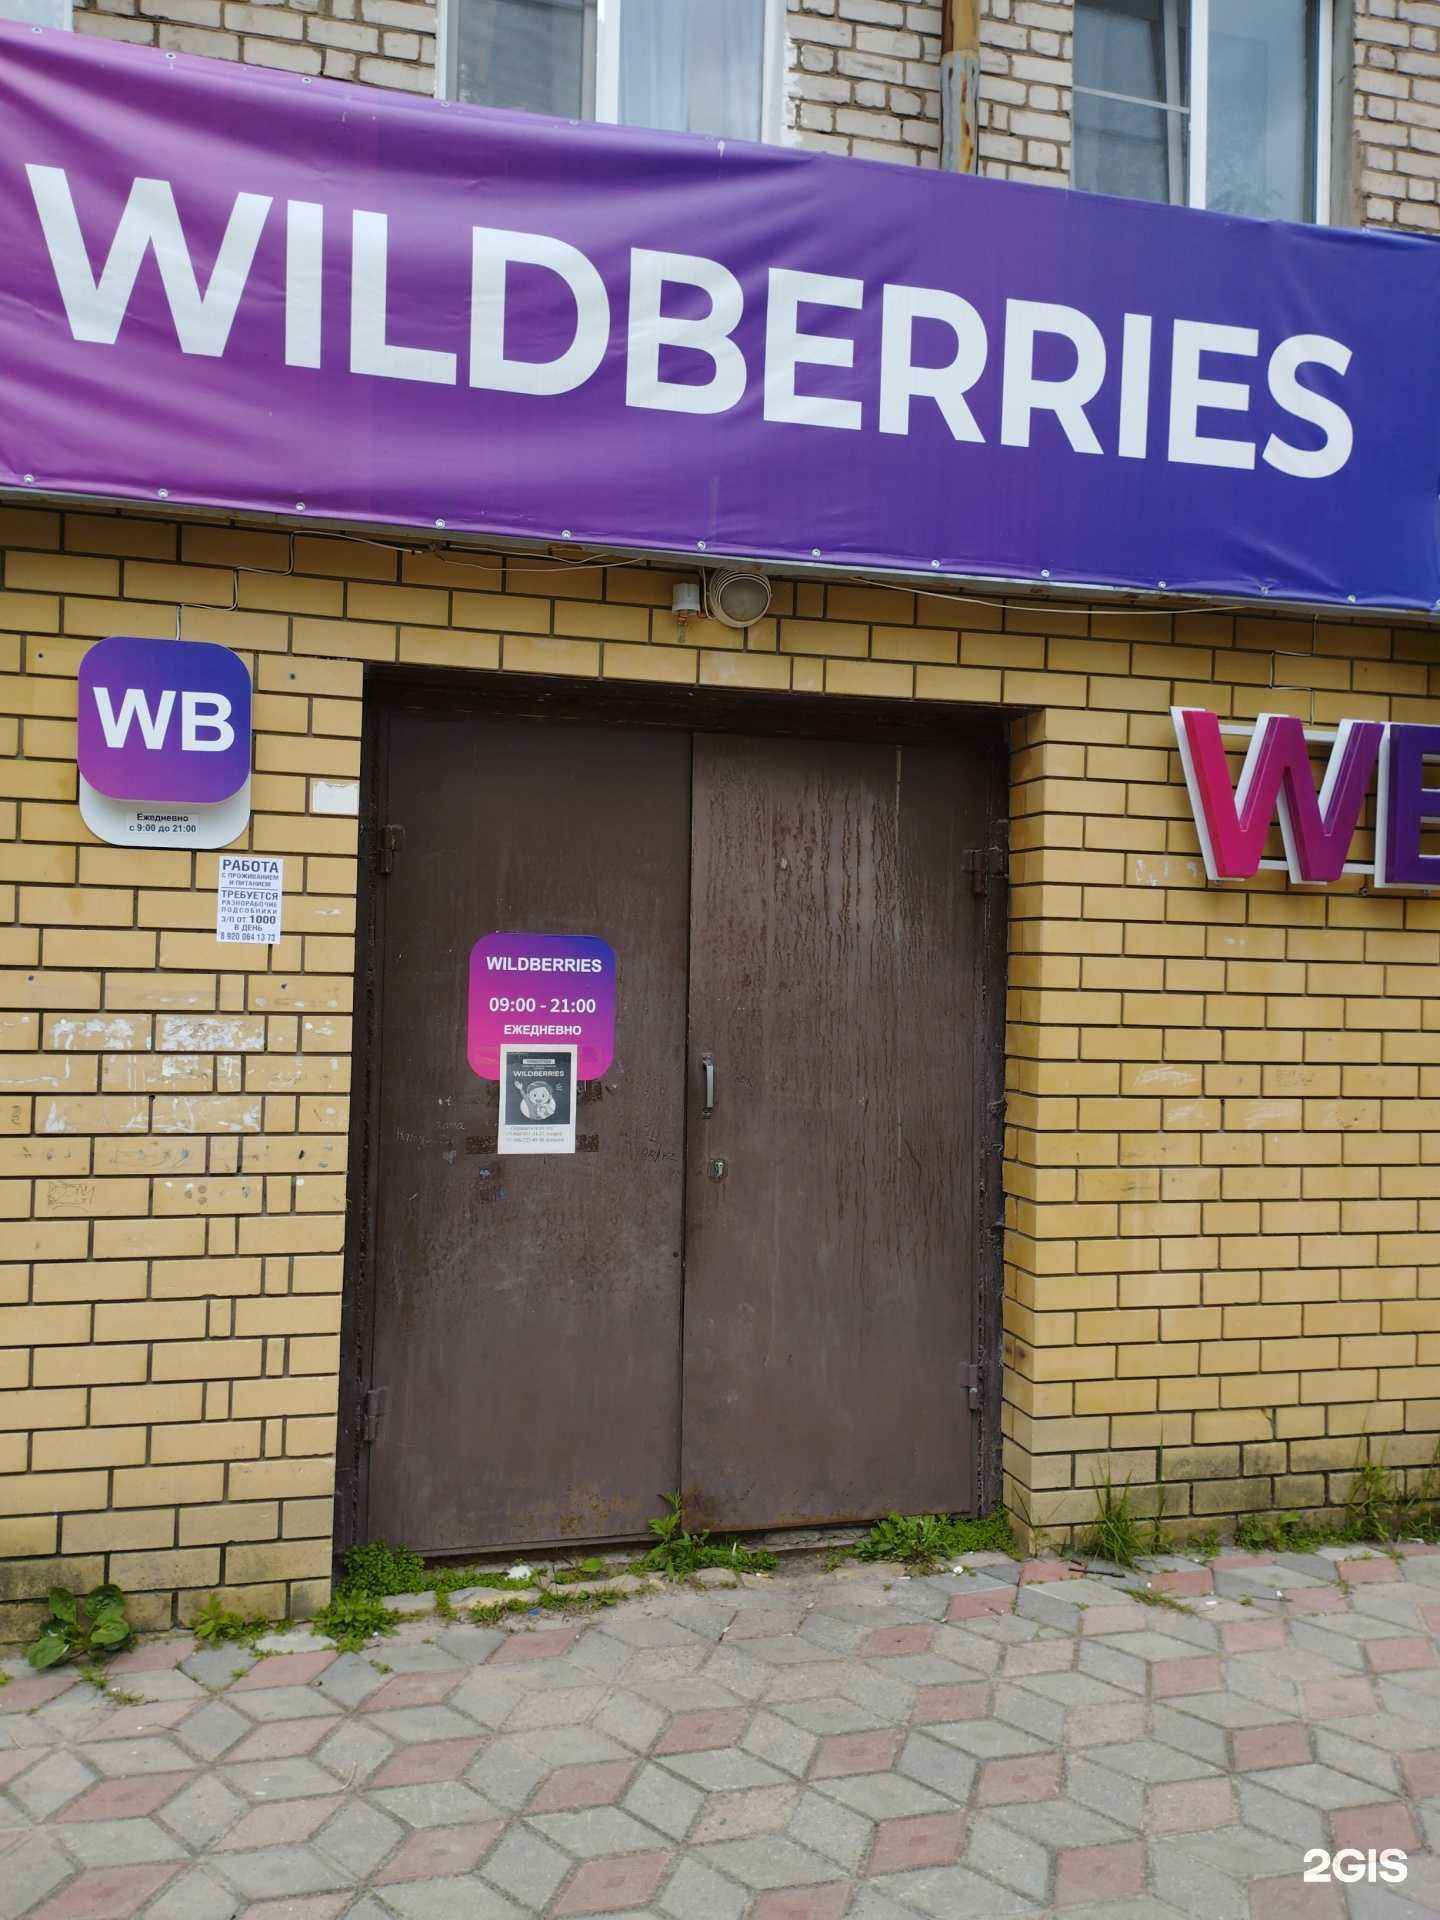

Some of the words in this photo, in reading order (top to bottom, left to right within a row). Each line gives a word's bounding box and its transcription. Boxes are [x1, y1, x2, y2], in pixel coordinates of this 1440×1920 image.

[25, 163, 1354, 478] WILDBERRIES
[93, 687, 235, 752] WB
[136, 813, 189, 823] Ежедневно
[137, 824, 156, 832] 9:00
[173, 824, 197, 833] 21:00
[223, 860, 279, 873] РАБОТА
[222, 890, 279, 900] ТРЕБУЕТСЯ
[249, 915, 276, 924] 1000
[486, 956, 602, 972] WILDBERRIES
[489, 997, 536, 1013] 09:00
[550, 999, 596, 1013] 21:00
[503, 1024, 582, 1036] ЕЖЕДНЕВНО
